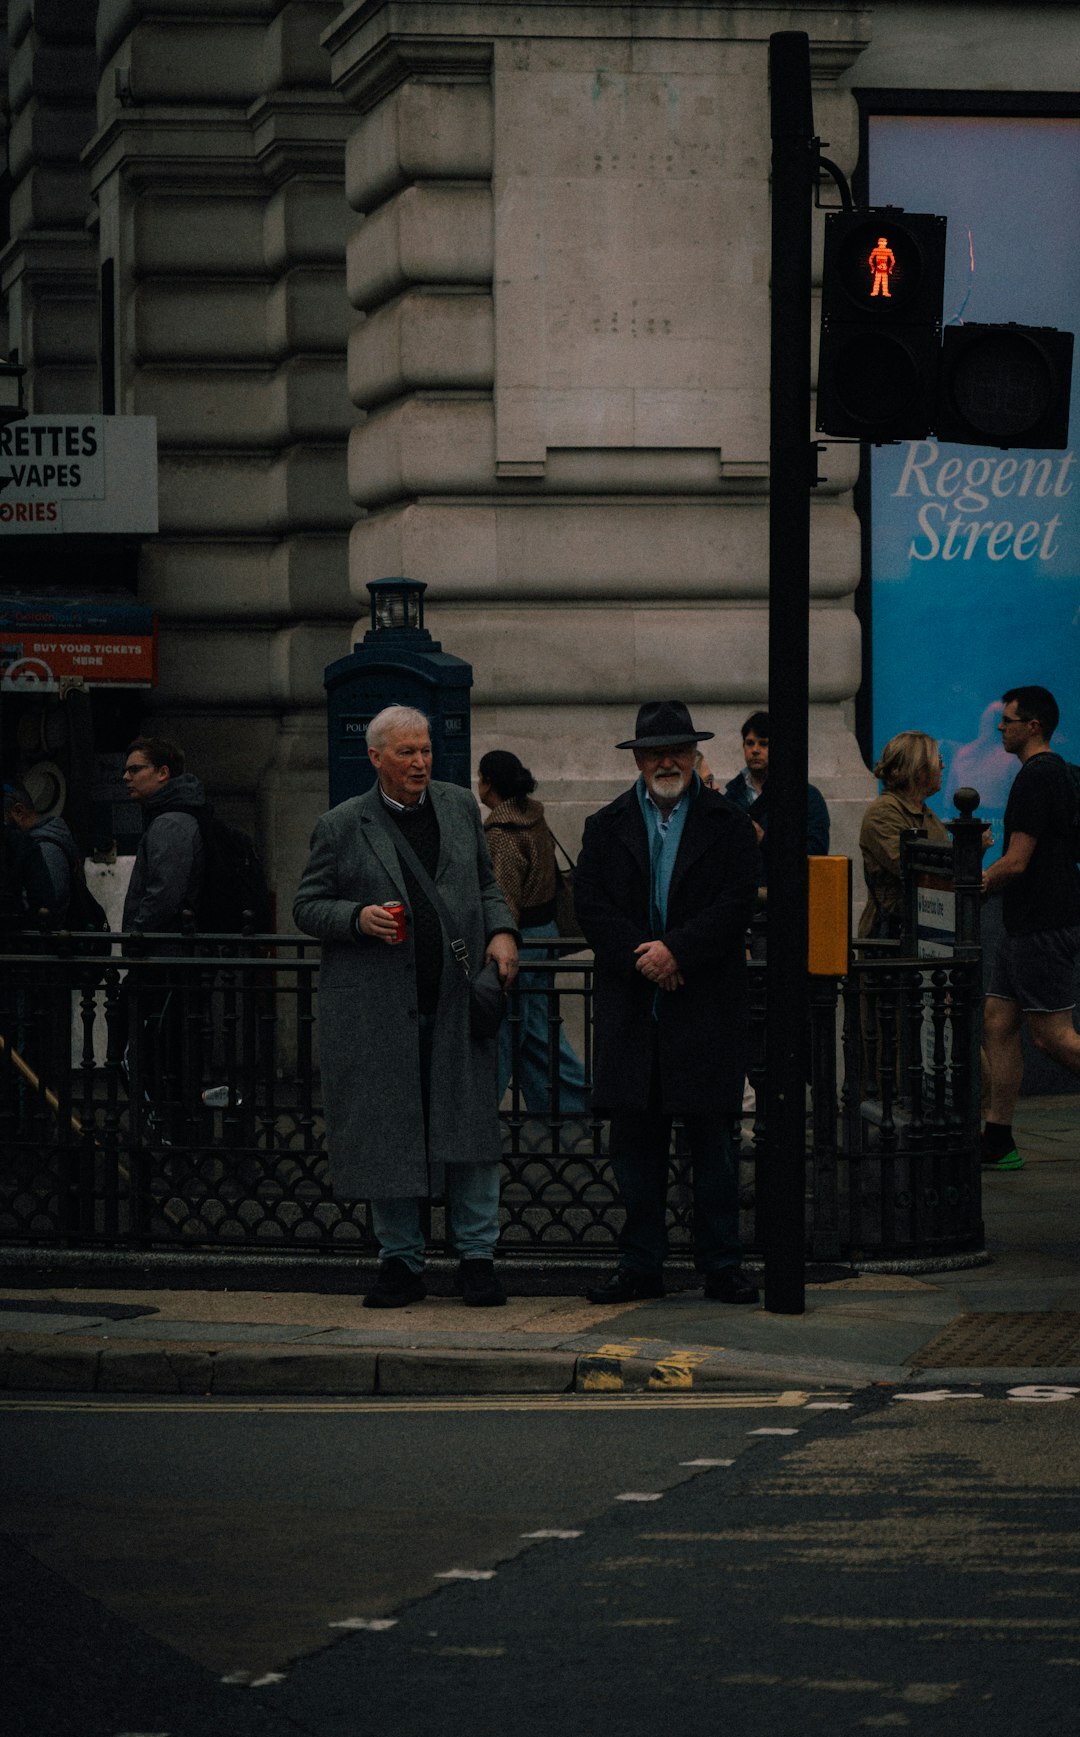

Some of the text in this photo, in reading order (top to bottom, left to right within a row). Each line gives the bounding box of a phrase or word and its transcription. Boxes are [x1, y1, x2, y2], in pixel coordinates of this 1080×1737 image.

[10, 464, 81, 487] VAPES
[890, 440, 1077, 513] Regent
[908, 502, 1063, 561] Street
[33, 643, 142, 654] BUY YOUR TICKETS
